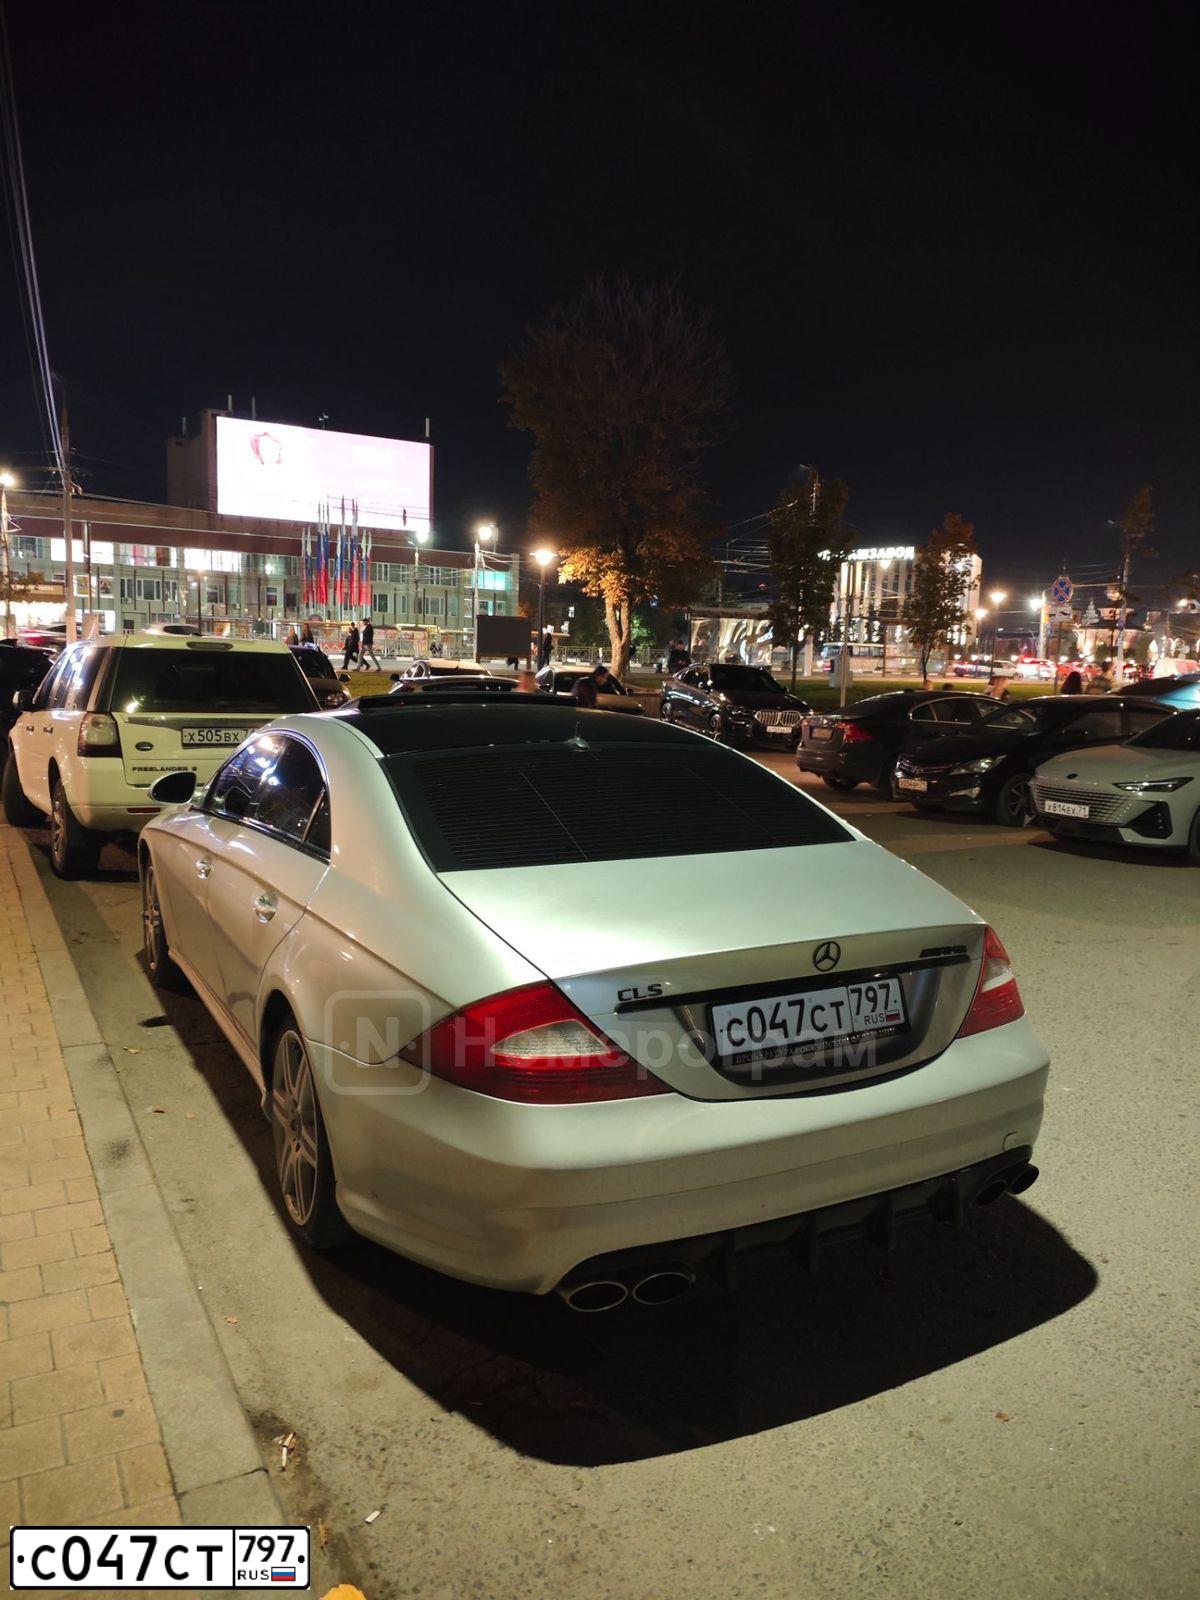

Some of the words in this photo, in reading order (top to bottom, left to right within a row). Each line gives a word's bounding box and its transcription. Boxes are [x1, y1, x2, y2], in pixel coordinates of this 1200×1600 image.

[188, 729, 240, 742] Х505ВХ
[617, 983, 663, 1002] CLS
[726, 998, 845, 1047] С047СТ
[850, 982, 892, 1016] 797
[864, 1013, 885, 1026] RUS
